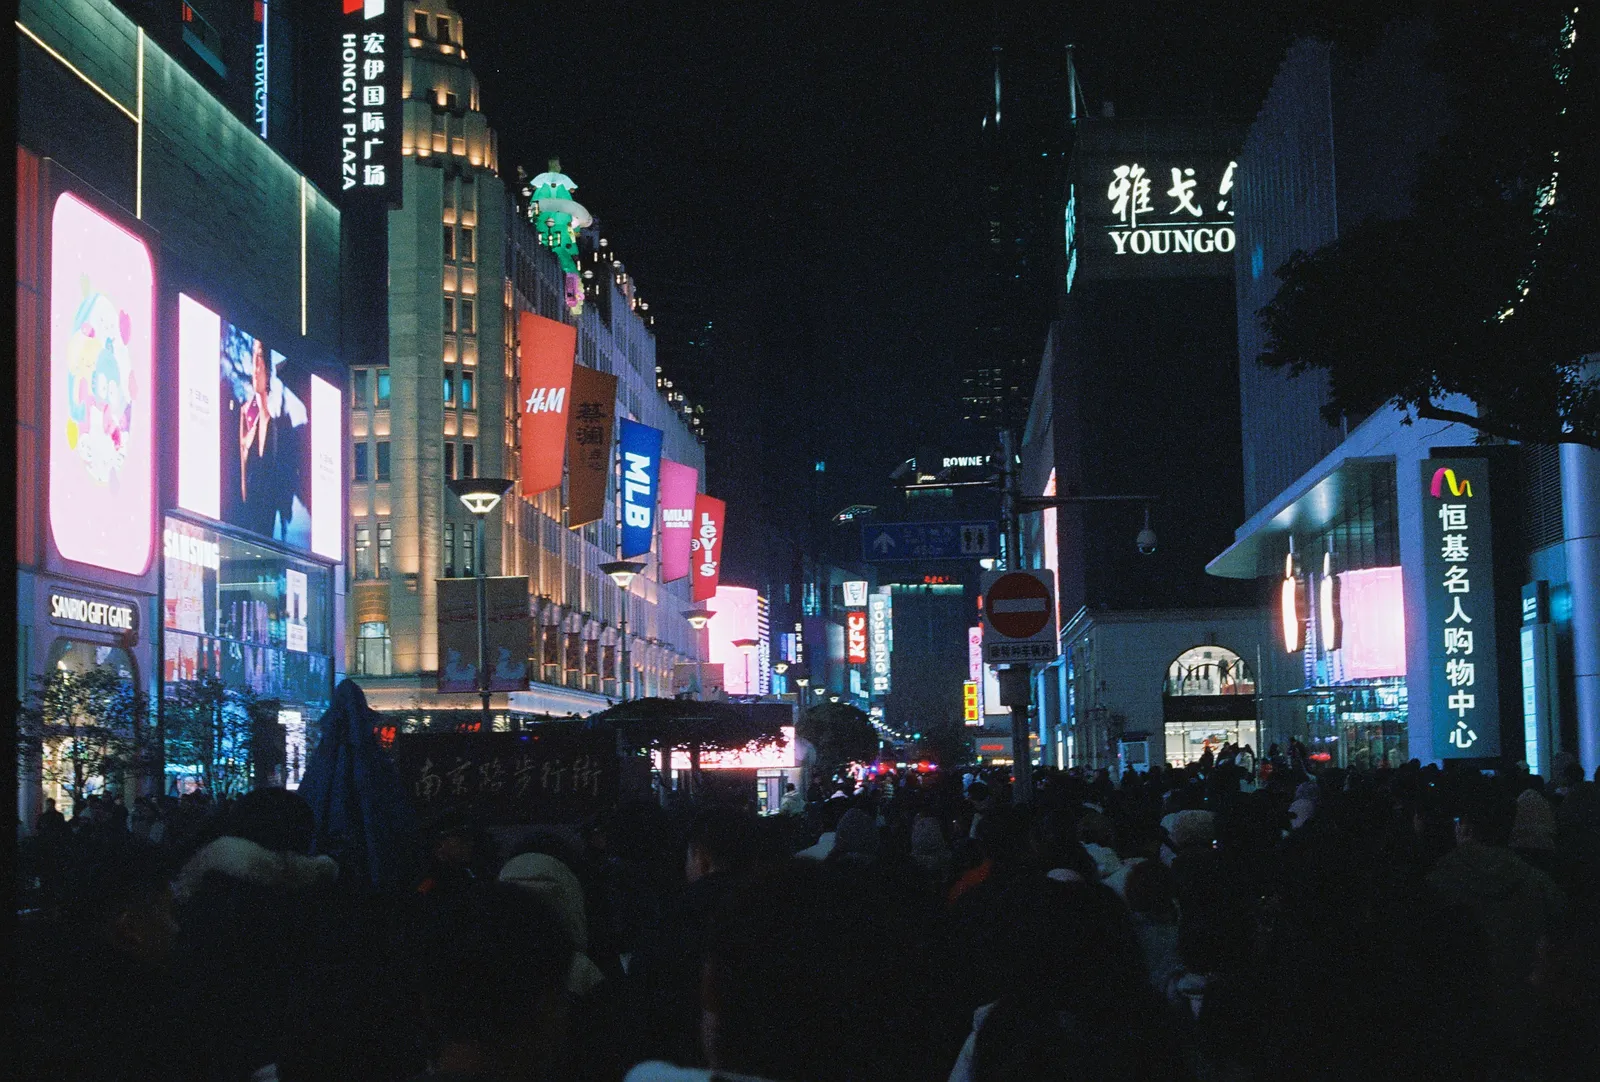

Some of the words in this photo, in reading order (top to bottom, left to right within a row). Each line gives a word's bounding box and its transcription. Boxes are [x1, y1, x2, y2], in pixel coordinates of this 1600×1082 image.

[342, 33, 357, 114] HONGYI
[362, 33, 385, 186] 宏伊国际广场
[342, 123, 357, 190] PLAZA
[1107, 227, 1237, 255] YOUNGO
[526, 387, 566, 414] H&M
[624, 451, 651, 529] MLB
[663, 508, 693, 521] MUJI
[163, 528, 220, 571] SAMSUNG
[51, 594, 88, 622] SANRIO
[88, 601, 110, 626] GIFT
[108, 605, 133, 630] GATE
[848, 616, 866, 659] KFC
[873, 600, 887, 673] BOSIDENG
[1439, 503, 1478, 749] 恒基名人购物中心
